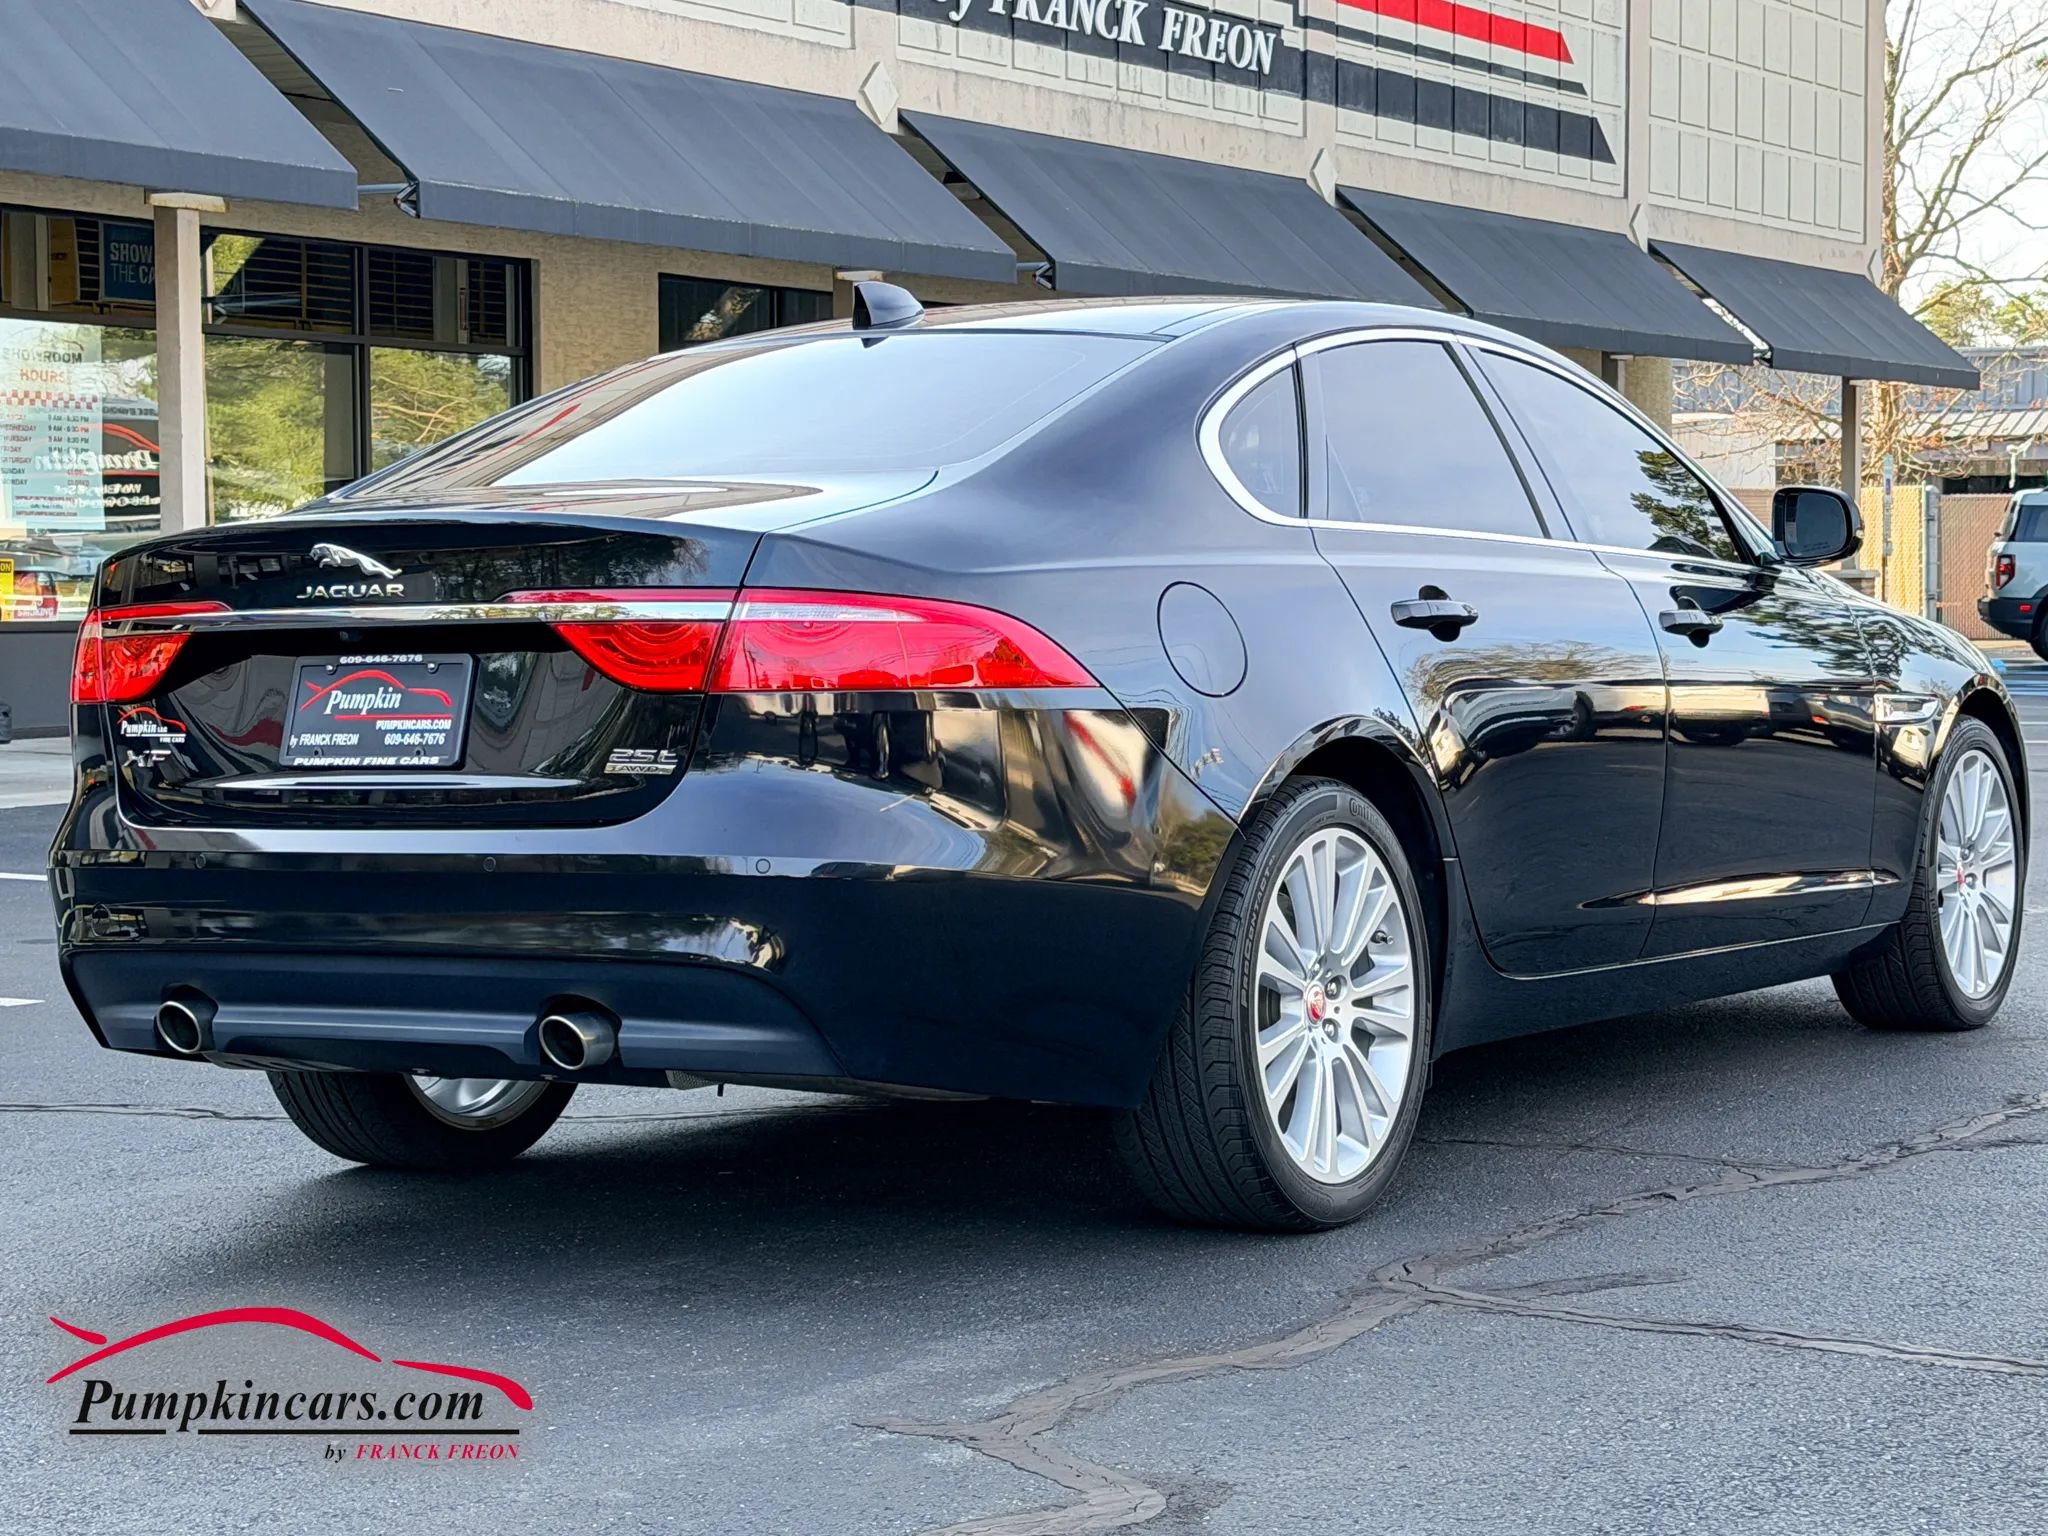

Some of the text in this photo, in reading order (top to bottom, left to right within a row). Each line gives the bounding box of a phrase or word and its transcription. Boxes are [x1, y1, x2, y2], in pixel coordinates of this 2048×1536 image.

[1157, 7, 1276, 75] FREON
[110, 242, 153, 264] SHOW
[110, 263, 137, 284] THE
[20, 368, 65, 384] HOURS
[296, 583, 405, 599] JAGUAR
[339, 654, 423, 665] 609-646-7676
[323, 686, 402, 716] Pumpkin
[120, 720, 157, 737] Pumpkin
[375, 719, 452, 731] PUMPKINCARS.COM
[289, 733, 360, 749] by FRANCK FREON
[384, 732, 446, 746] 609-646-7676
[122, 750, 172, 768] XF
[293, 755, 440, 767] PUMPKIN FINE CARS
